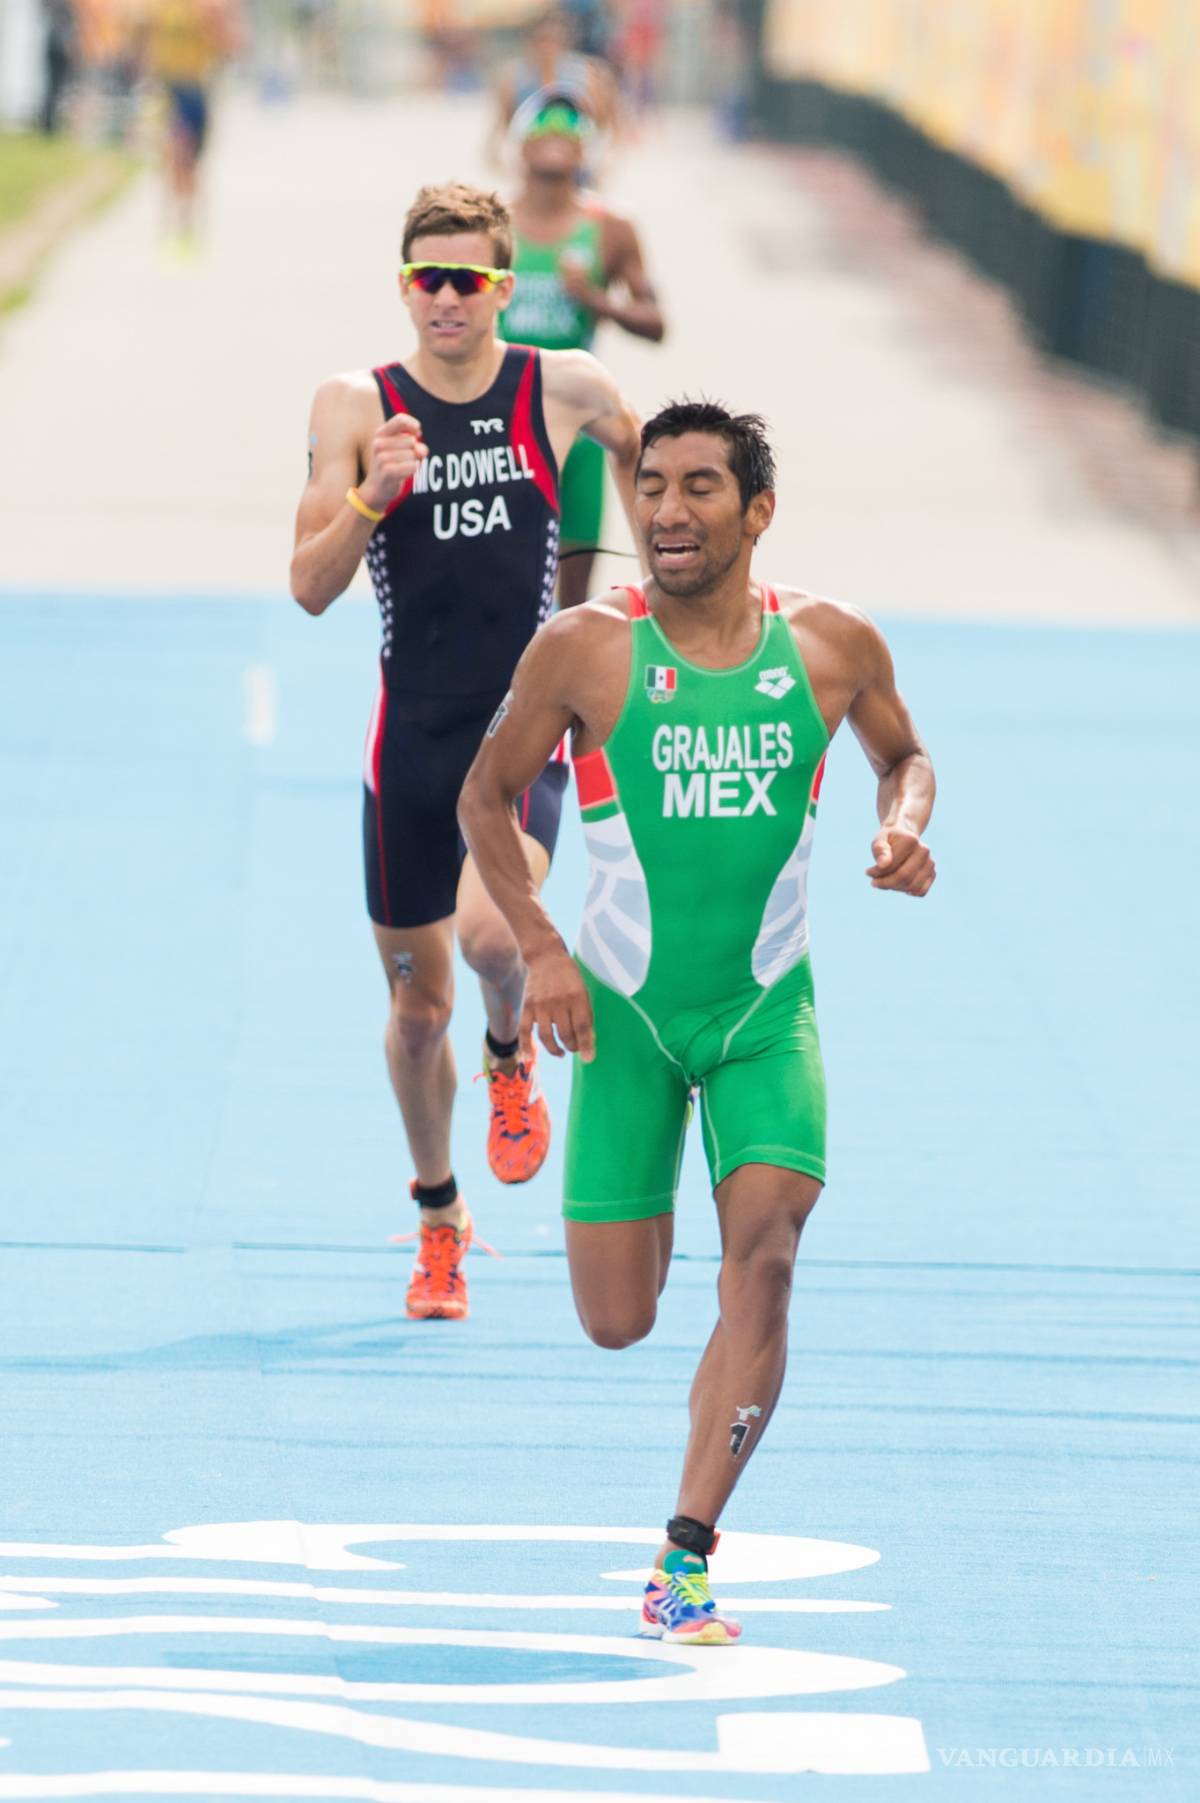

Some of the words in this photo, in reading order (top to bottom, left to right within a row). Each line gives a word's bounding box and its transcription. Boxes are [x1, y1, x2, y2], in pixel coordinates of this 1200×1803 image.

[470, 418, 505, 435] TYR
[412, 455, 443, 494] MC
[446, 444, 535, 490] DOWELL
[433, 495, 512, 540] USA
[652, 721, 794, 772] GRAJALES
[662, 770, 778, 818] MEX
